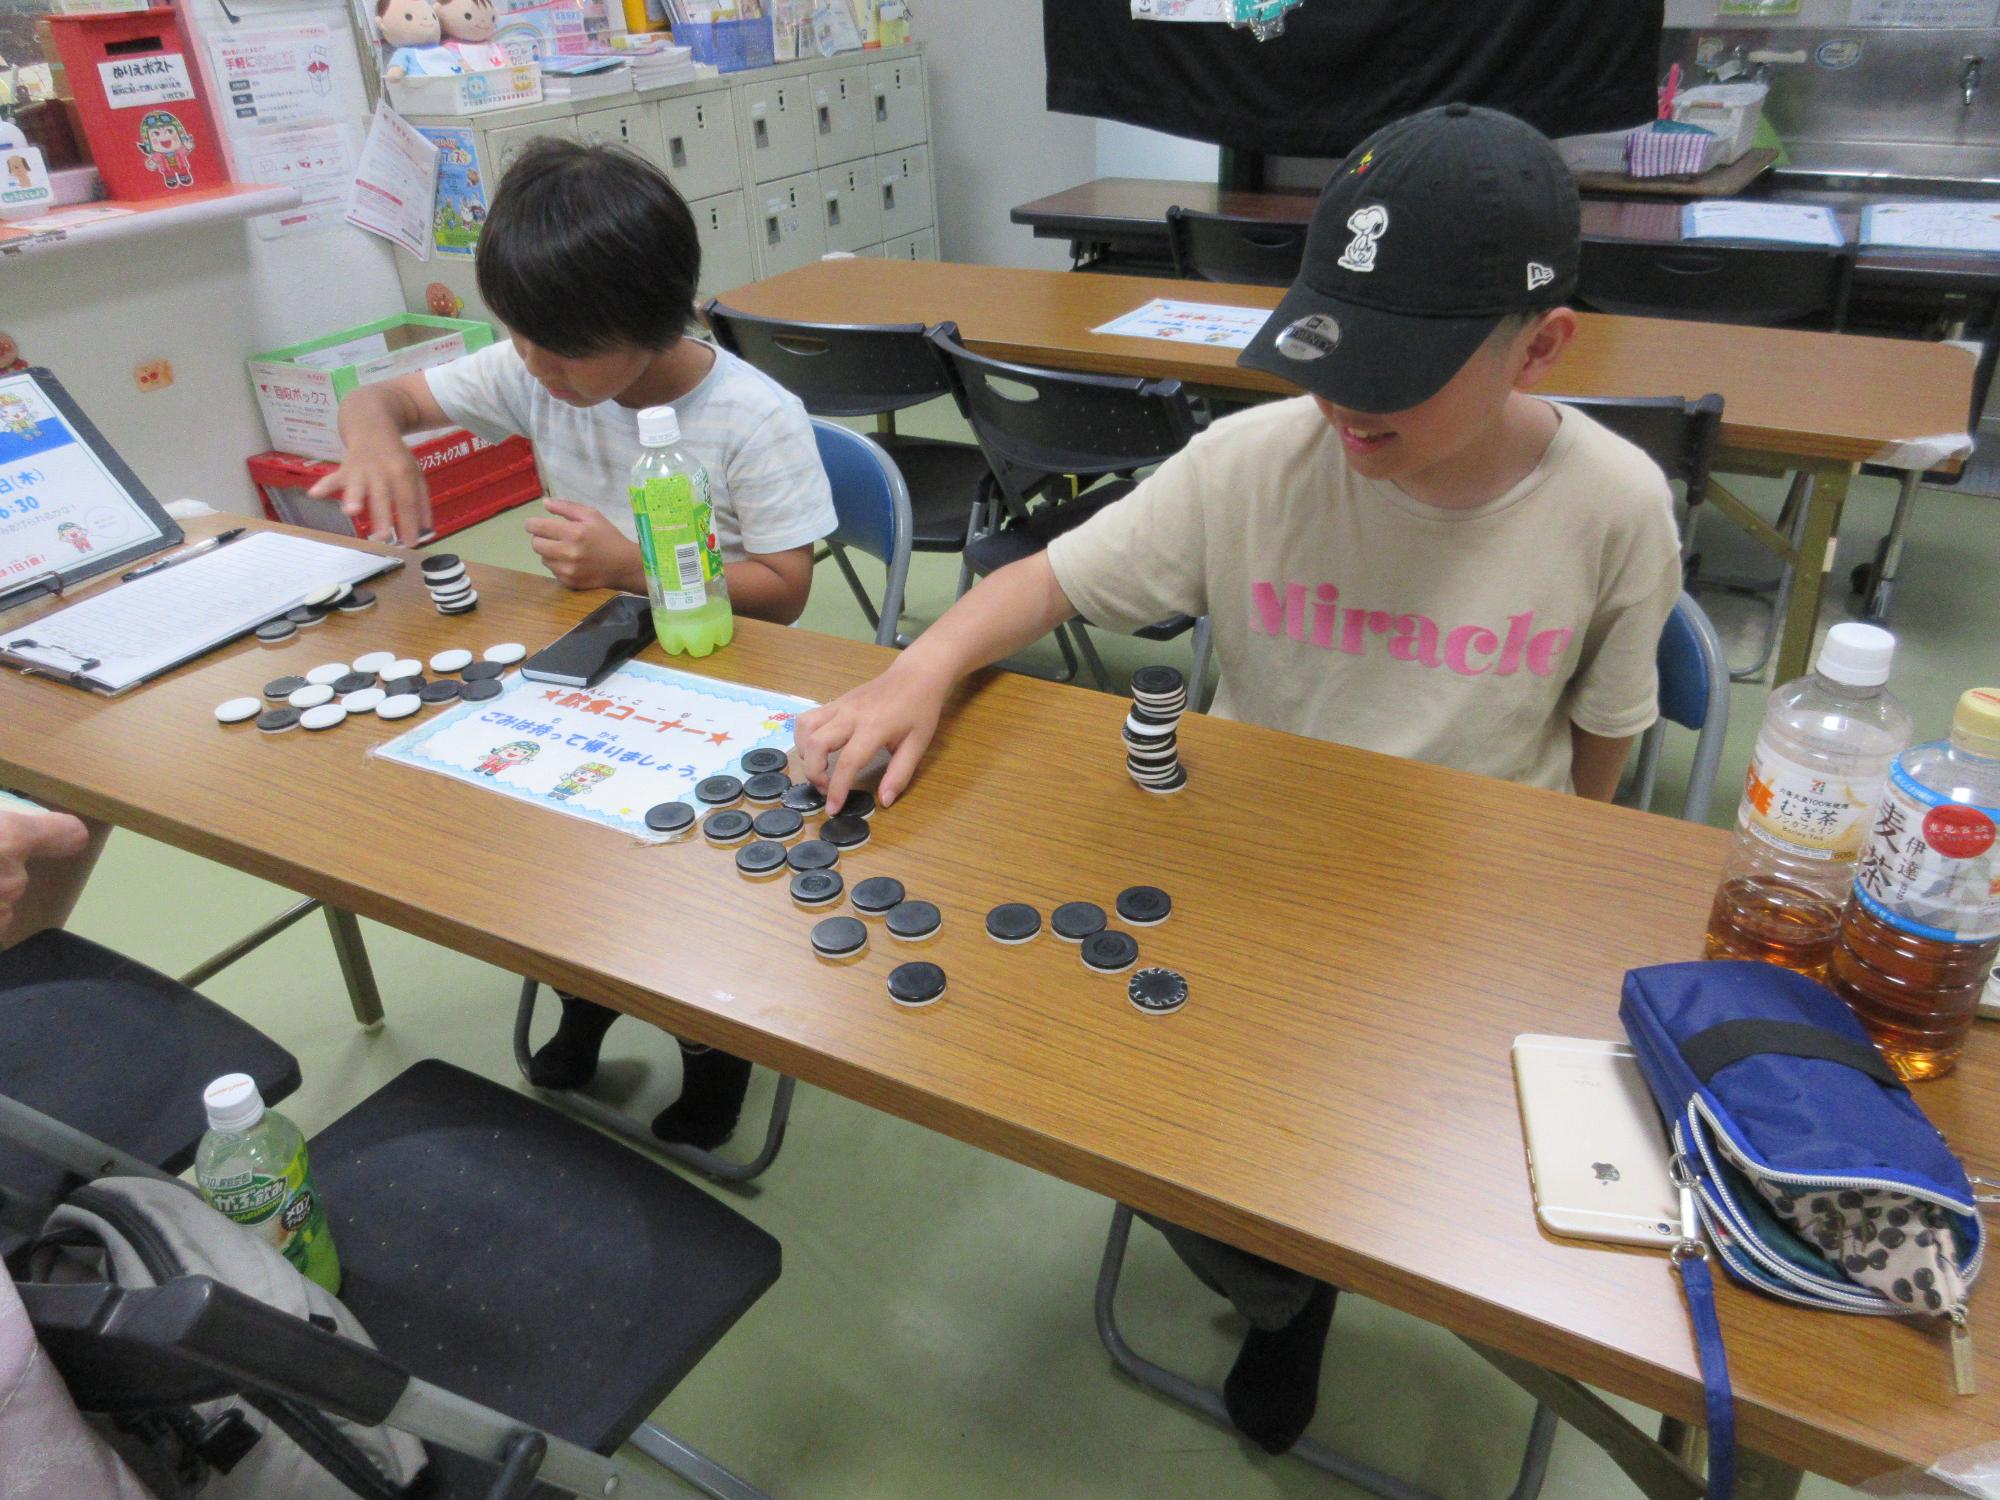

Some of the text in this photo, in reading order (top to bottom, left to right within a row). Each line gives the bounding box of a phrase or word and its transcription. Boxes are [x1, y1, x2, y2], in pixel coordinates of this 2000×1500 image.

[273, 385, 331, 406] 回収ボックス
[1250, 581, 1576, 677] Miracle
[555, 691, 707, 736] 飲食コーナー
[480, 710, 698, 782] ごみは持って帰りましょう。
[1780, 799, 1839, 827] むぎ茶
[1861, 799, 1907, 898] 麦茶
